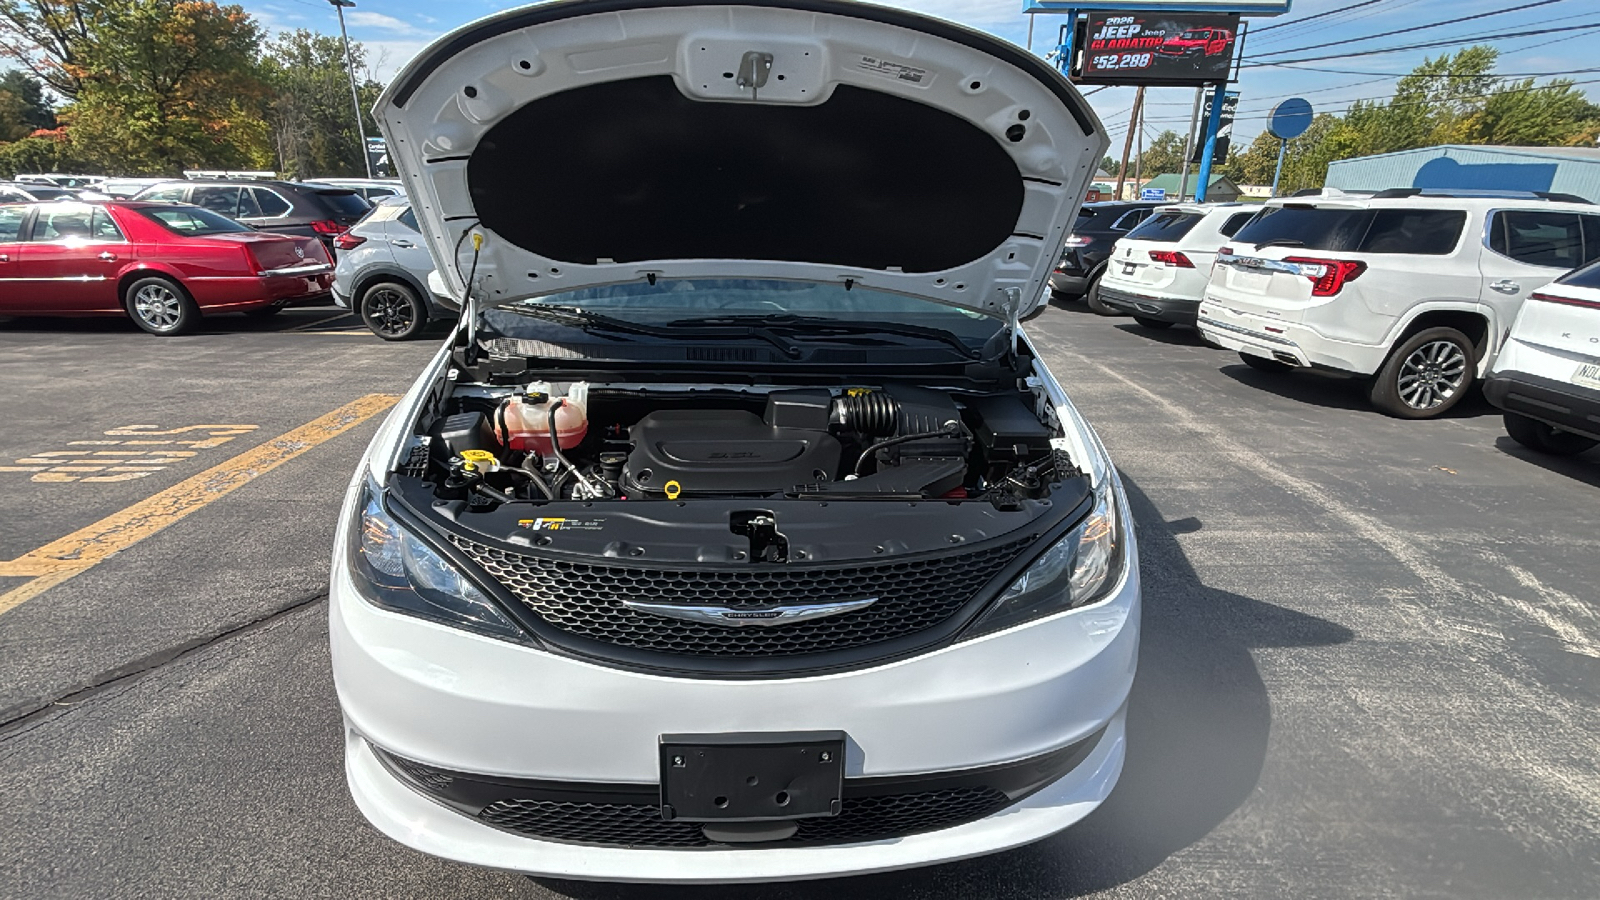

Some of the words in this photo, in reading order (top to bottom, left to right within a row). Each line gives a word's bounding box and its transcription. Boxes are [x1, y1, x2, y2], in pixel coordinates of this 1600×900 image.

[1093, 25, 1141, 40] JEEP
[1141, 29, 1166, 37] Jeep
[1091, 36, 1163, 50] GLADIATOR
[1093, 53, 1150, 70] $52,288
